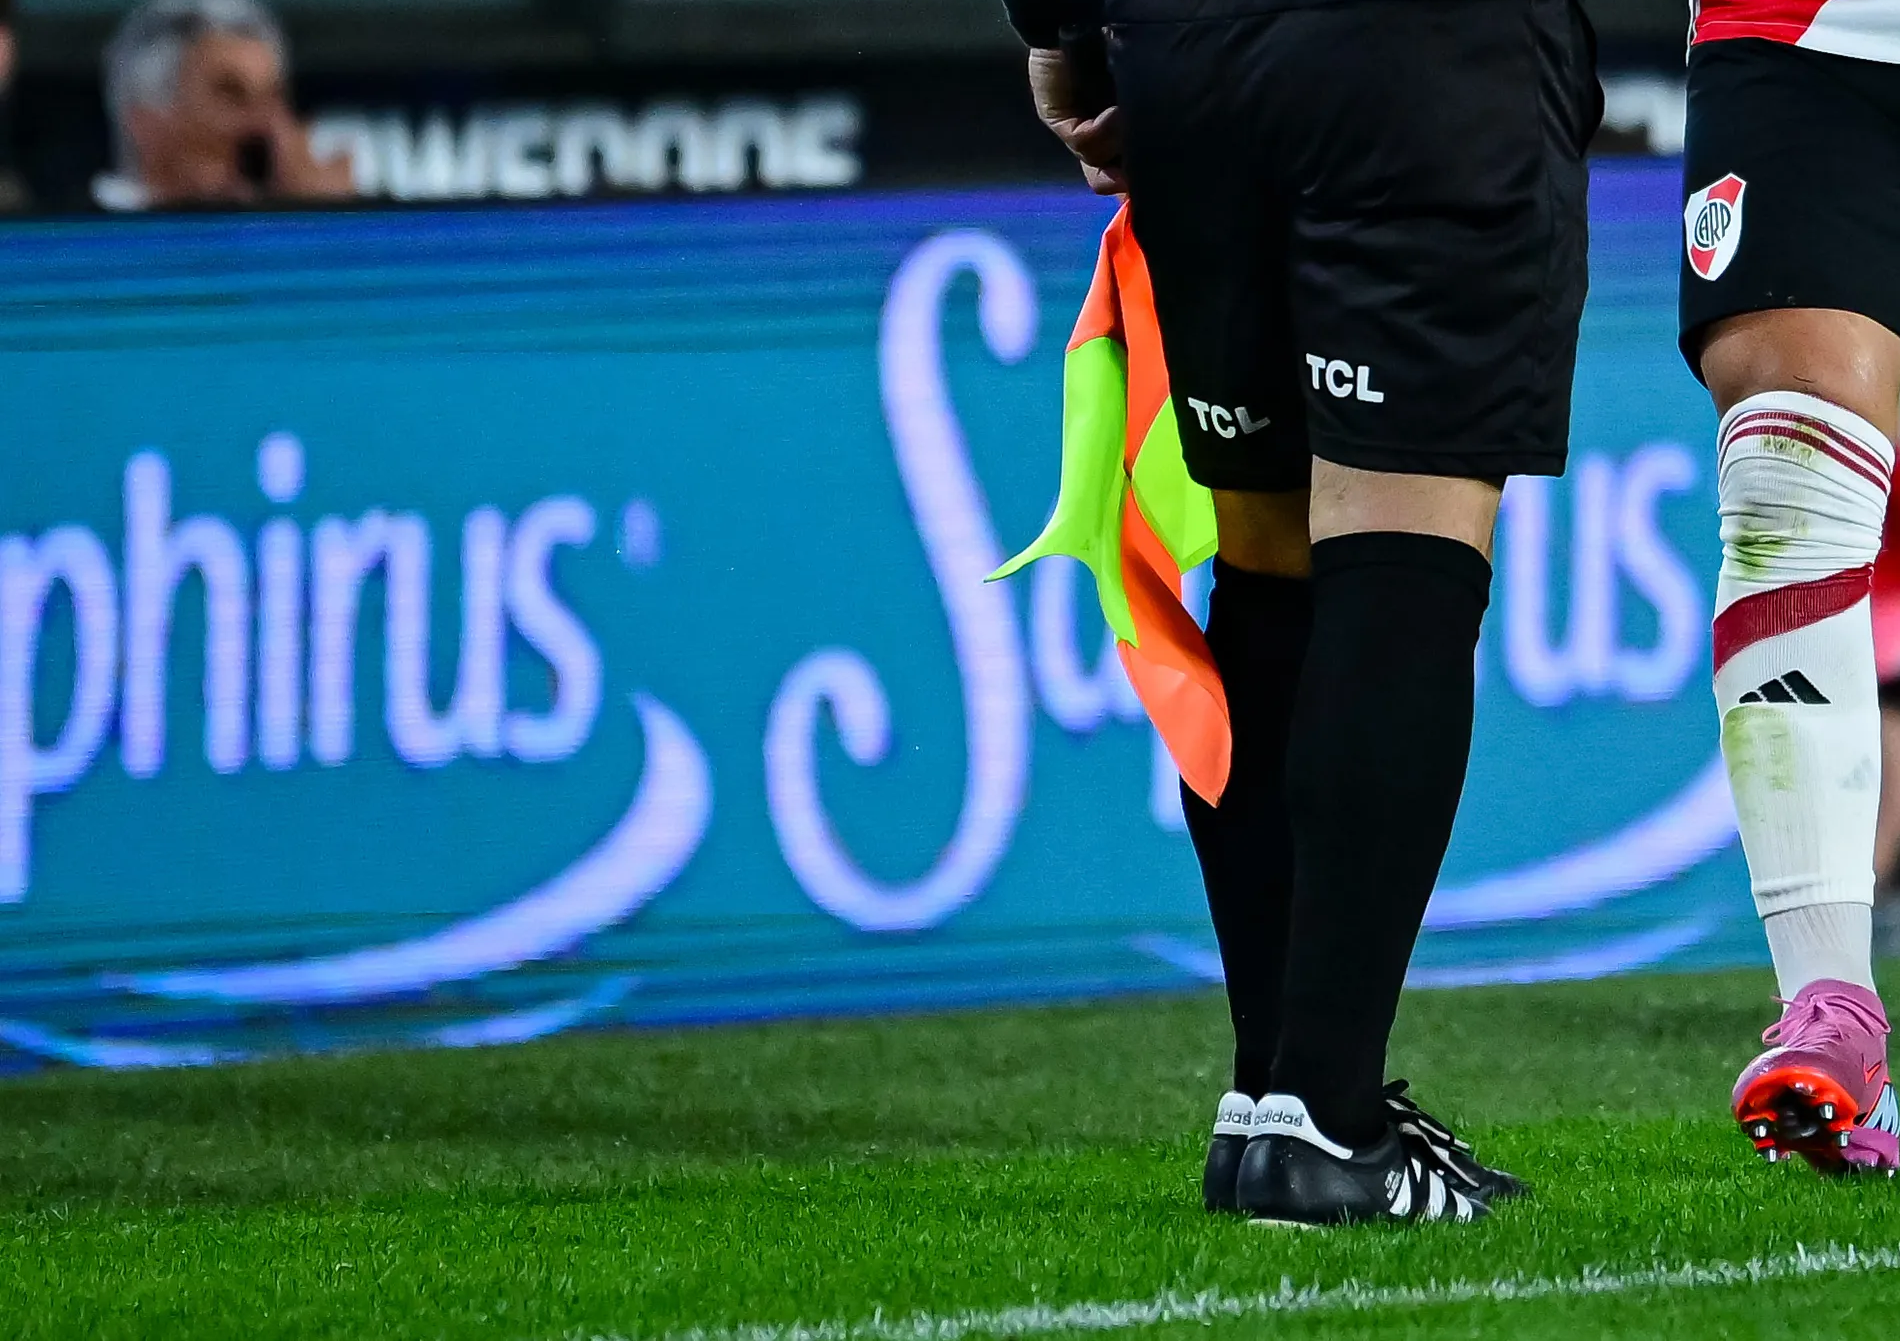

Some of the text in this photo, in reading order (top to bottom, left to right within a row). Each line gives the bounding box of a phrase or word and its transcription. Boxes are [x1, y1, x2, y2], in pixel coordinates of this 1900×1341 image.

[1694, 201, 1731, 249] CARP
[1306, 353, 1384, 403] TCL
[1188, 397, 1270, 439] TCL
[1254, 1110, 1305, 1128] adidas
